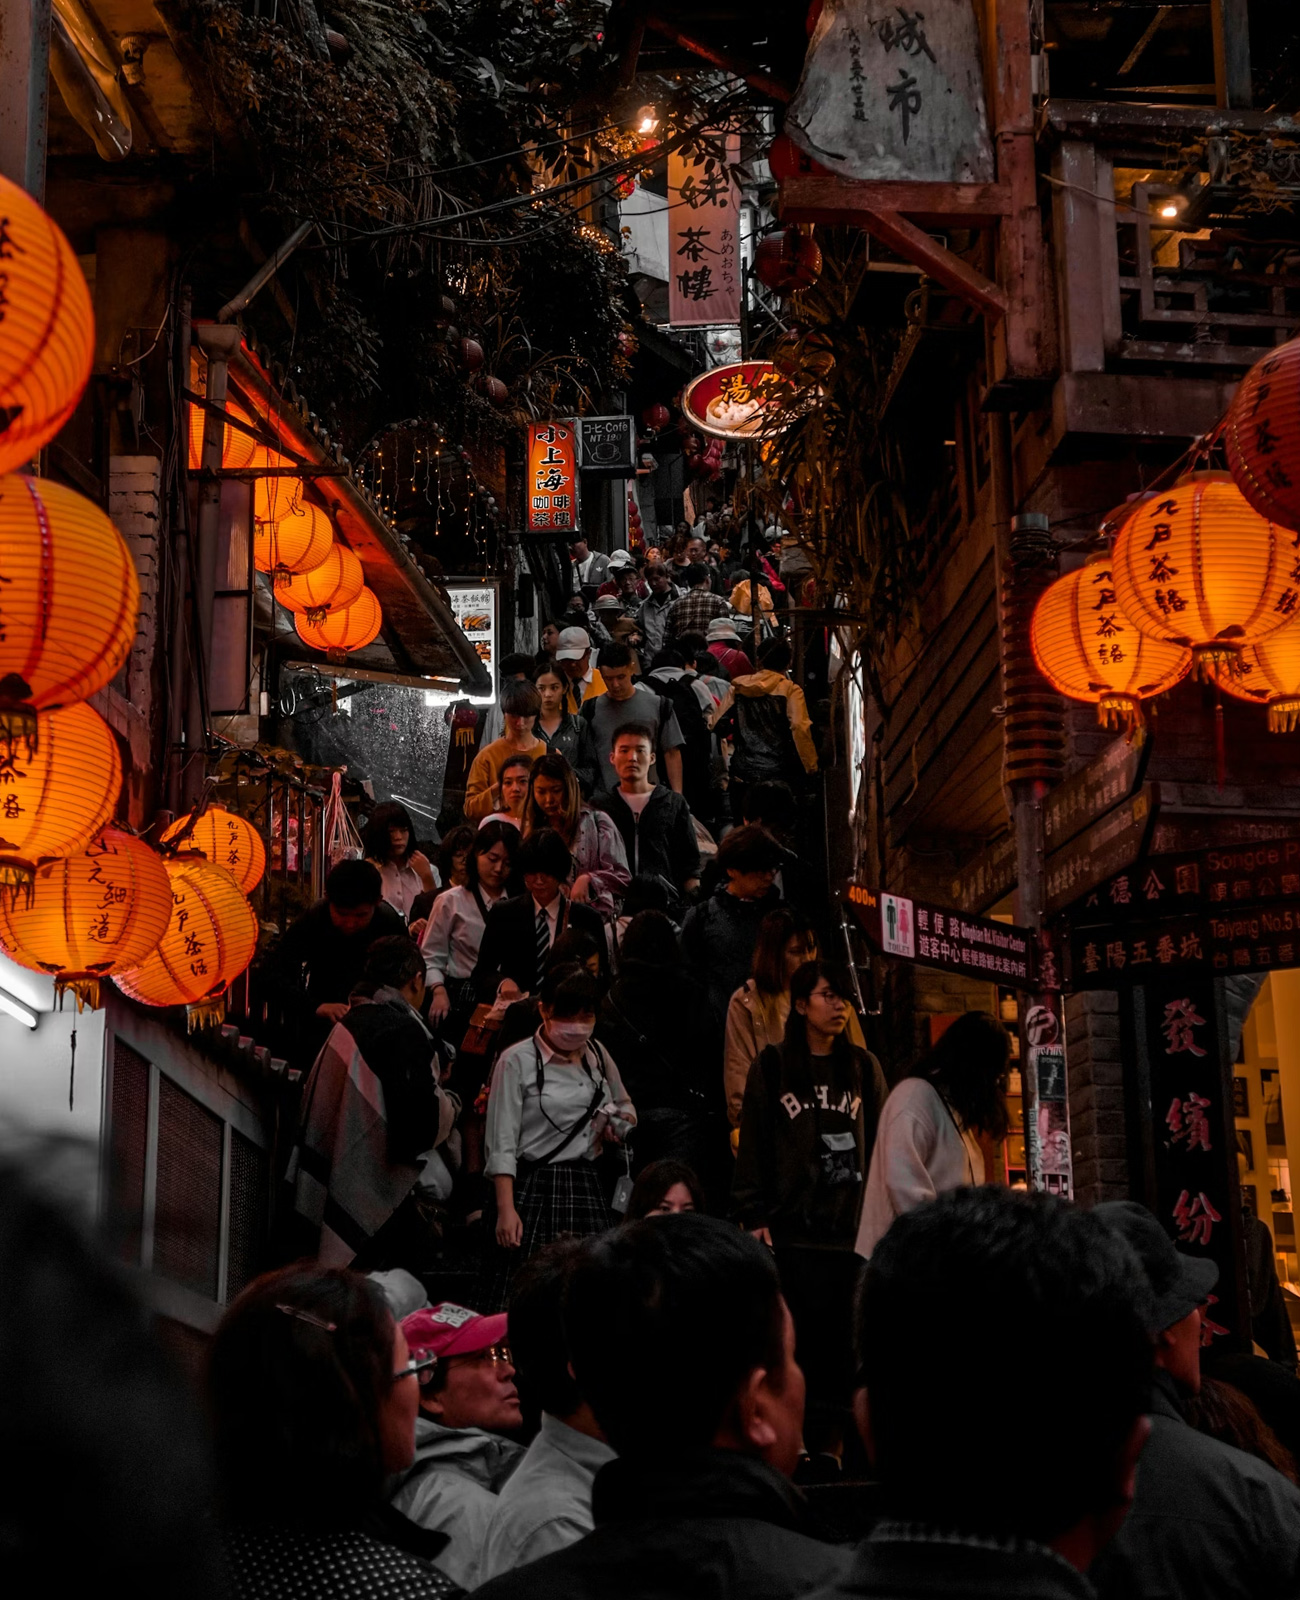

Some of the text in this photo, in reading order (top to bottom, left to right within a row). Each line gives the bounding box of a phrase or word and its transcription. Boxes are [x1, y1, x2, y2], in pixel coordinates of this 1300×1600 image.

[879, 7, 937, 145] 城市
[719, 228, 735, 296] あめおちゃ
[536, 424, 570, 492] 小上海
[532, 494, 571, 509] 咖啡
[532, 511, 571, 527] 茶樓
[1209, 917, 1260, 941] Taiyang
[887, 941, 910, 955] TOILET
[919, 934, 961, 964] 遊客中心
[1081, 931, 1204, 974] 臺陽五番坑
